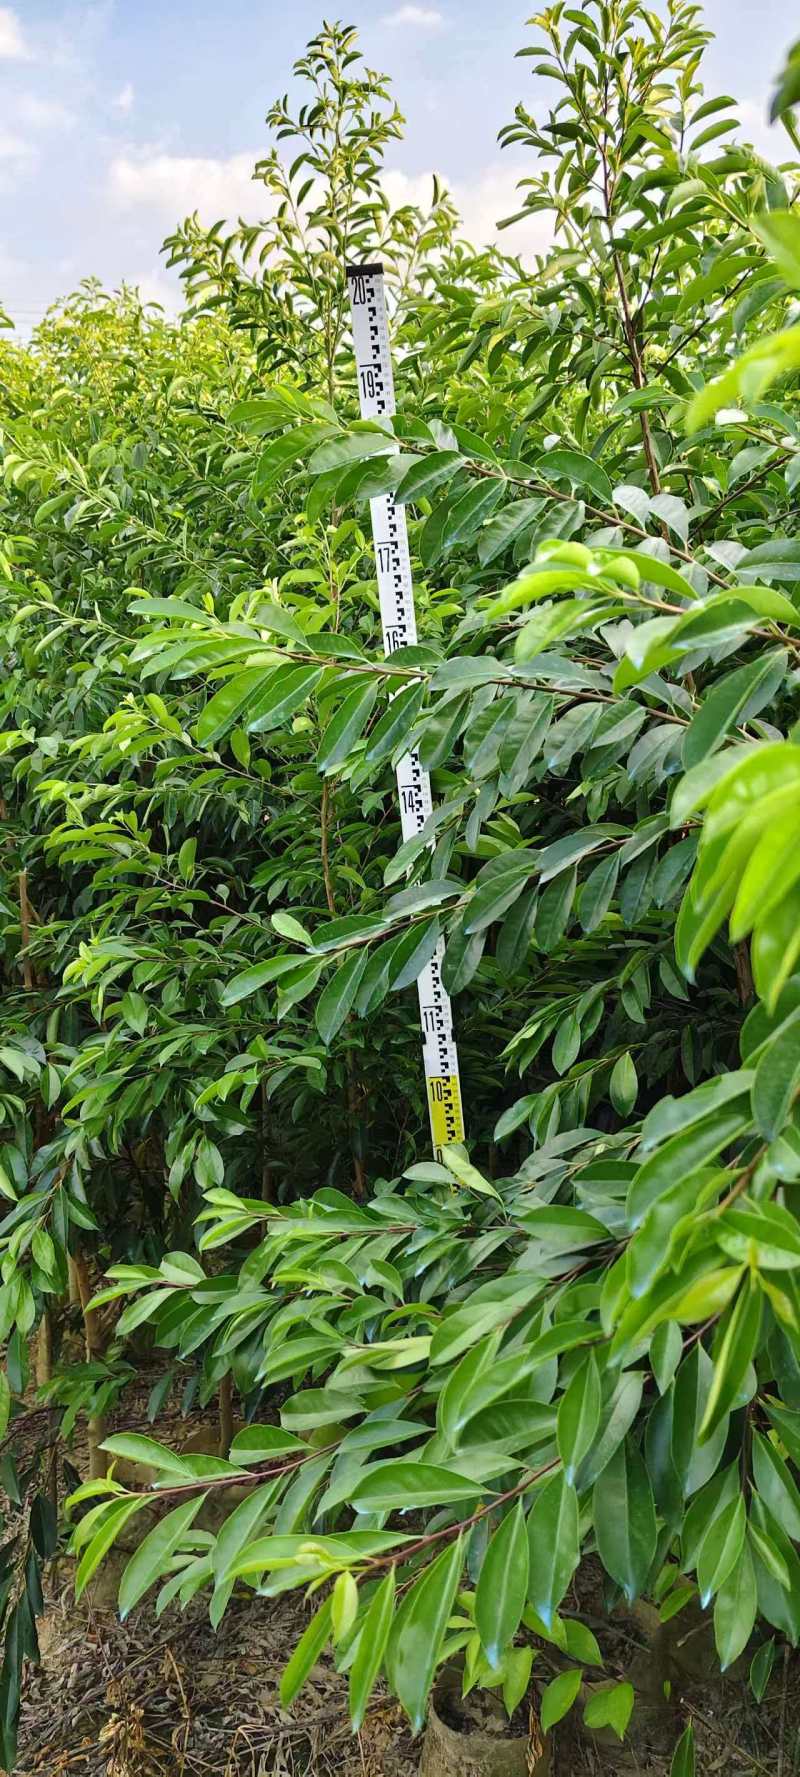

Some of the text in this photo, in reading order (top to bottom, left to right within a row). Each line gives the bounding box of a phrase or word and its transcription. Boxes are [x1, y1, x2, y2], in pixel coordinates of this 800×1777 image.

[351, 276, 366, 305] 20
[360, 370, 375, 399] 19
[377, 547, 390, 573] 17
[385, 630, 400, 654] 16
[401, 790, 415, 814] 14
[423, 1010, 435, 1032] 11
[430, 1080, 443, 1102] 10
